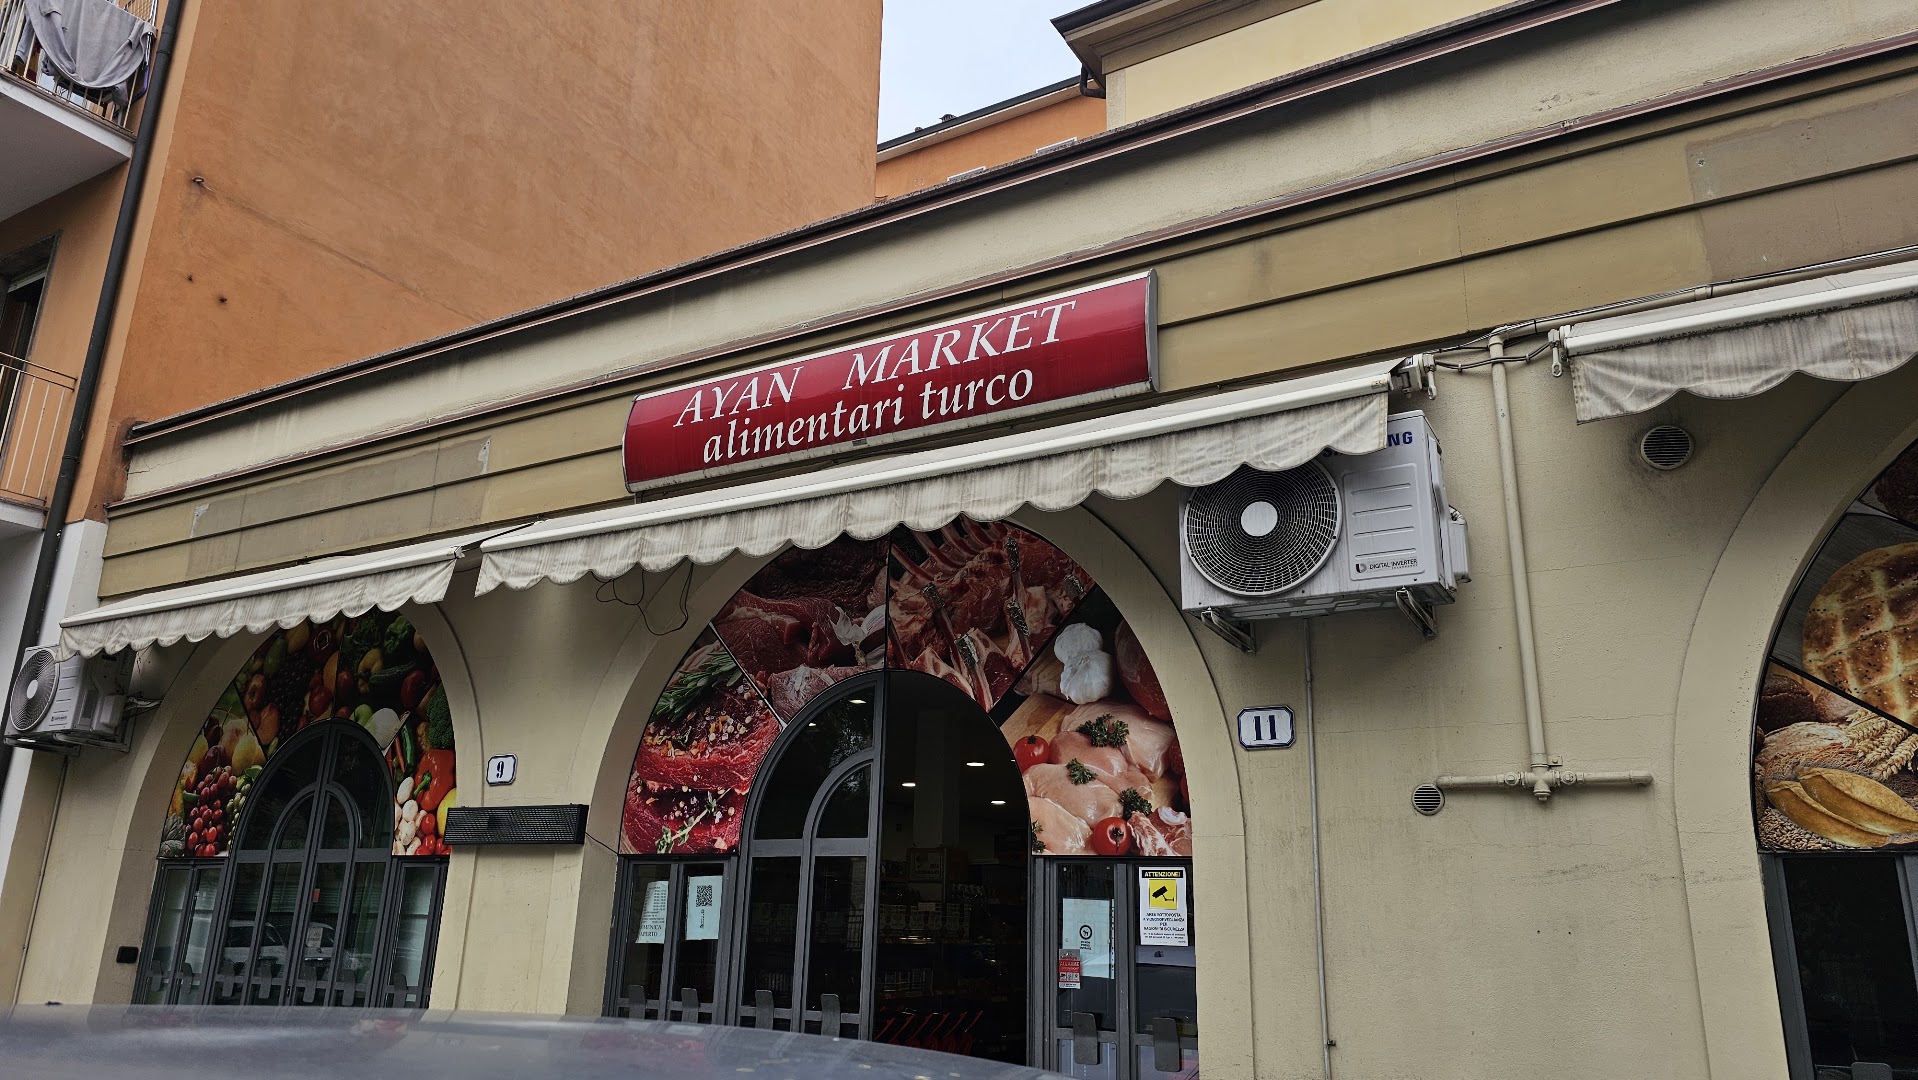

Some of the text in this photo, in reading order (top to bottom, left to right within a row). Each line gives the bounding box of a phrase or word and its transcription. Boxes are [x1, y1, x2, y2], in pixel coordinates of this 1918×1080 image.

[672, 300, 1077, 428] AYAN MARKET
[703, 369, 1033, 464] alimentari turco
[1252, 714, 1279, 741] 11
[496, 760, 505, 779] 9
